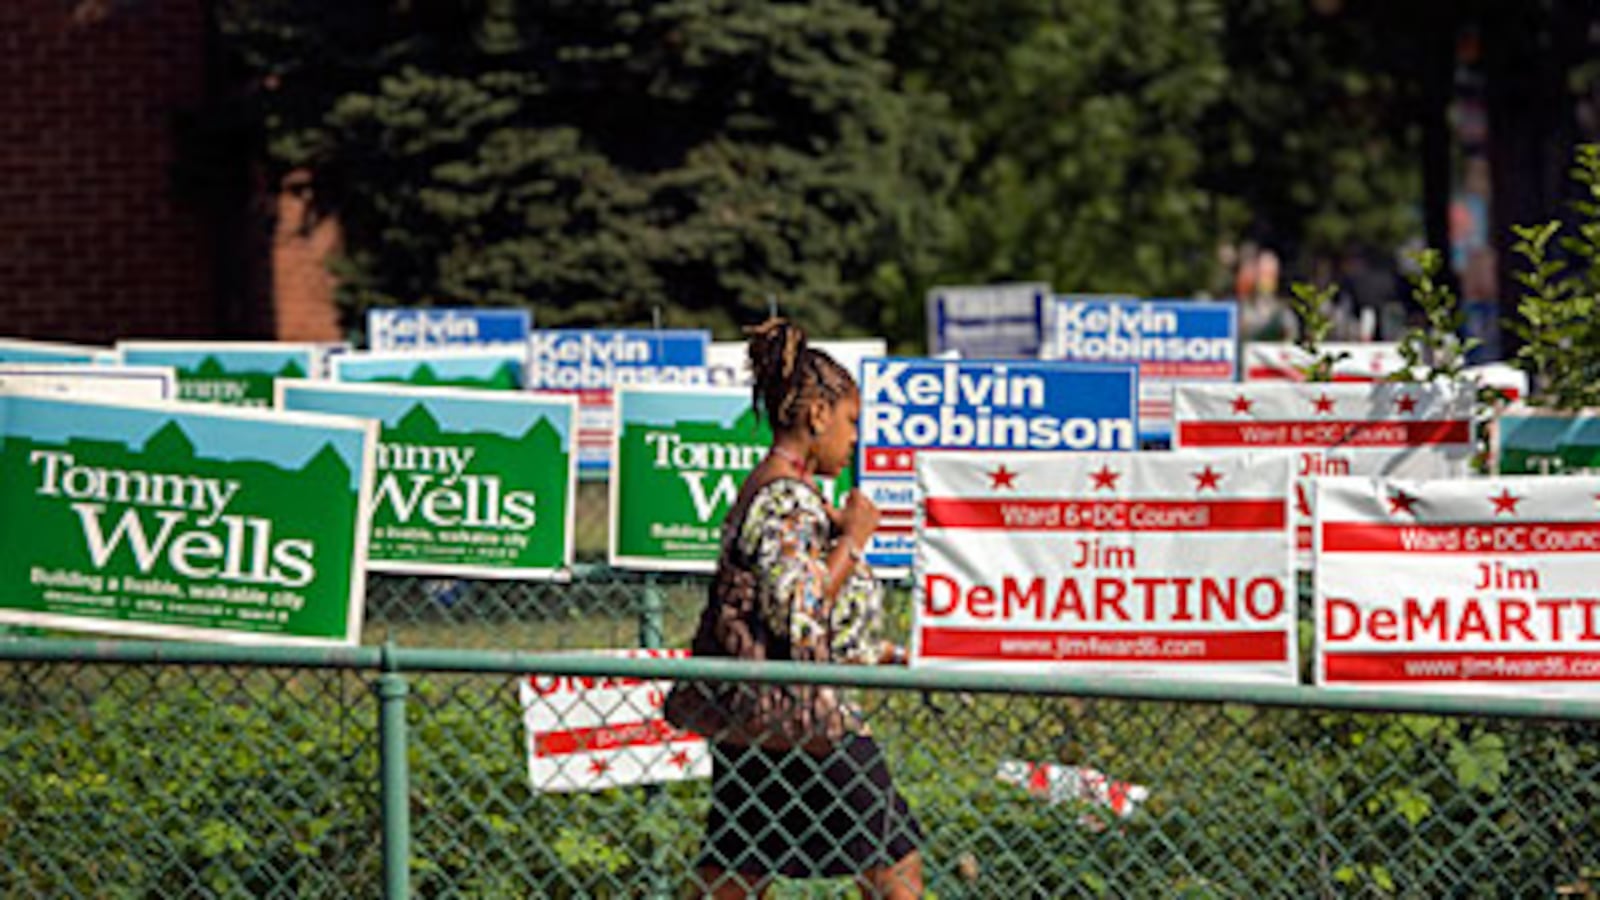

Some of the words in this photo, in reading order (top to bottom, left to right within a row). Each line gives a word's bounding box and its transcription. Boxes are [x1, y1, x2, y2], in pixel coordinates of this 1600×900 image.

[372, 309, 480, 340] Kelvin
[1057, 301, 1179, 333] Kelvin
[532, 331, 652, 364] Kelvin
[1057, 334, 1234, 362] Robinson
[532, 362, 709, 388] Robinson
[864, 361, 1044, 405] Kelvin
[864, 404, 1134, 449] Robinson
[1239, 426, 1288, 442] Ward
[1344, 425, 1408, 442] Council
[375, 441, 476, 486] mmy
[645, 432, 760, 470] Tomm
[1298, 452, 1350, 477] Jim
[30, 450, 241, 525] Tommy
[366, 470, 537, 531] Wells
[1001, 504, 1061, 526] Ward
[1129, 504, 1211, 527] Council
[72, 502, 316, 588] Wells
[650, 521, 709, 542] Building
[1400, 527, 1460, 550] Ward
[1530, 527, 1600, 550] Counc
[1072, 540, 1137, 569] Jim
[30, 566, 103, 592] Building
[107, 576, 119, 591] a
[188, 582, 268, 605] walkable
[270, 590, 305, 611] city
[1474, 560, 1541, 591] Jim
[922, 573, 1286, 623] DeMARTINO
[1324, 597, 1600, 643] DeMARTI
[1000, 634, 1206, 660] www.jim4ward6.com
[1403, 656, 1600, 679] www.jim4ward6.co
